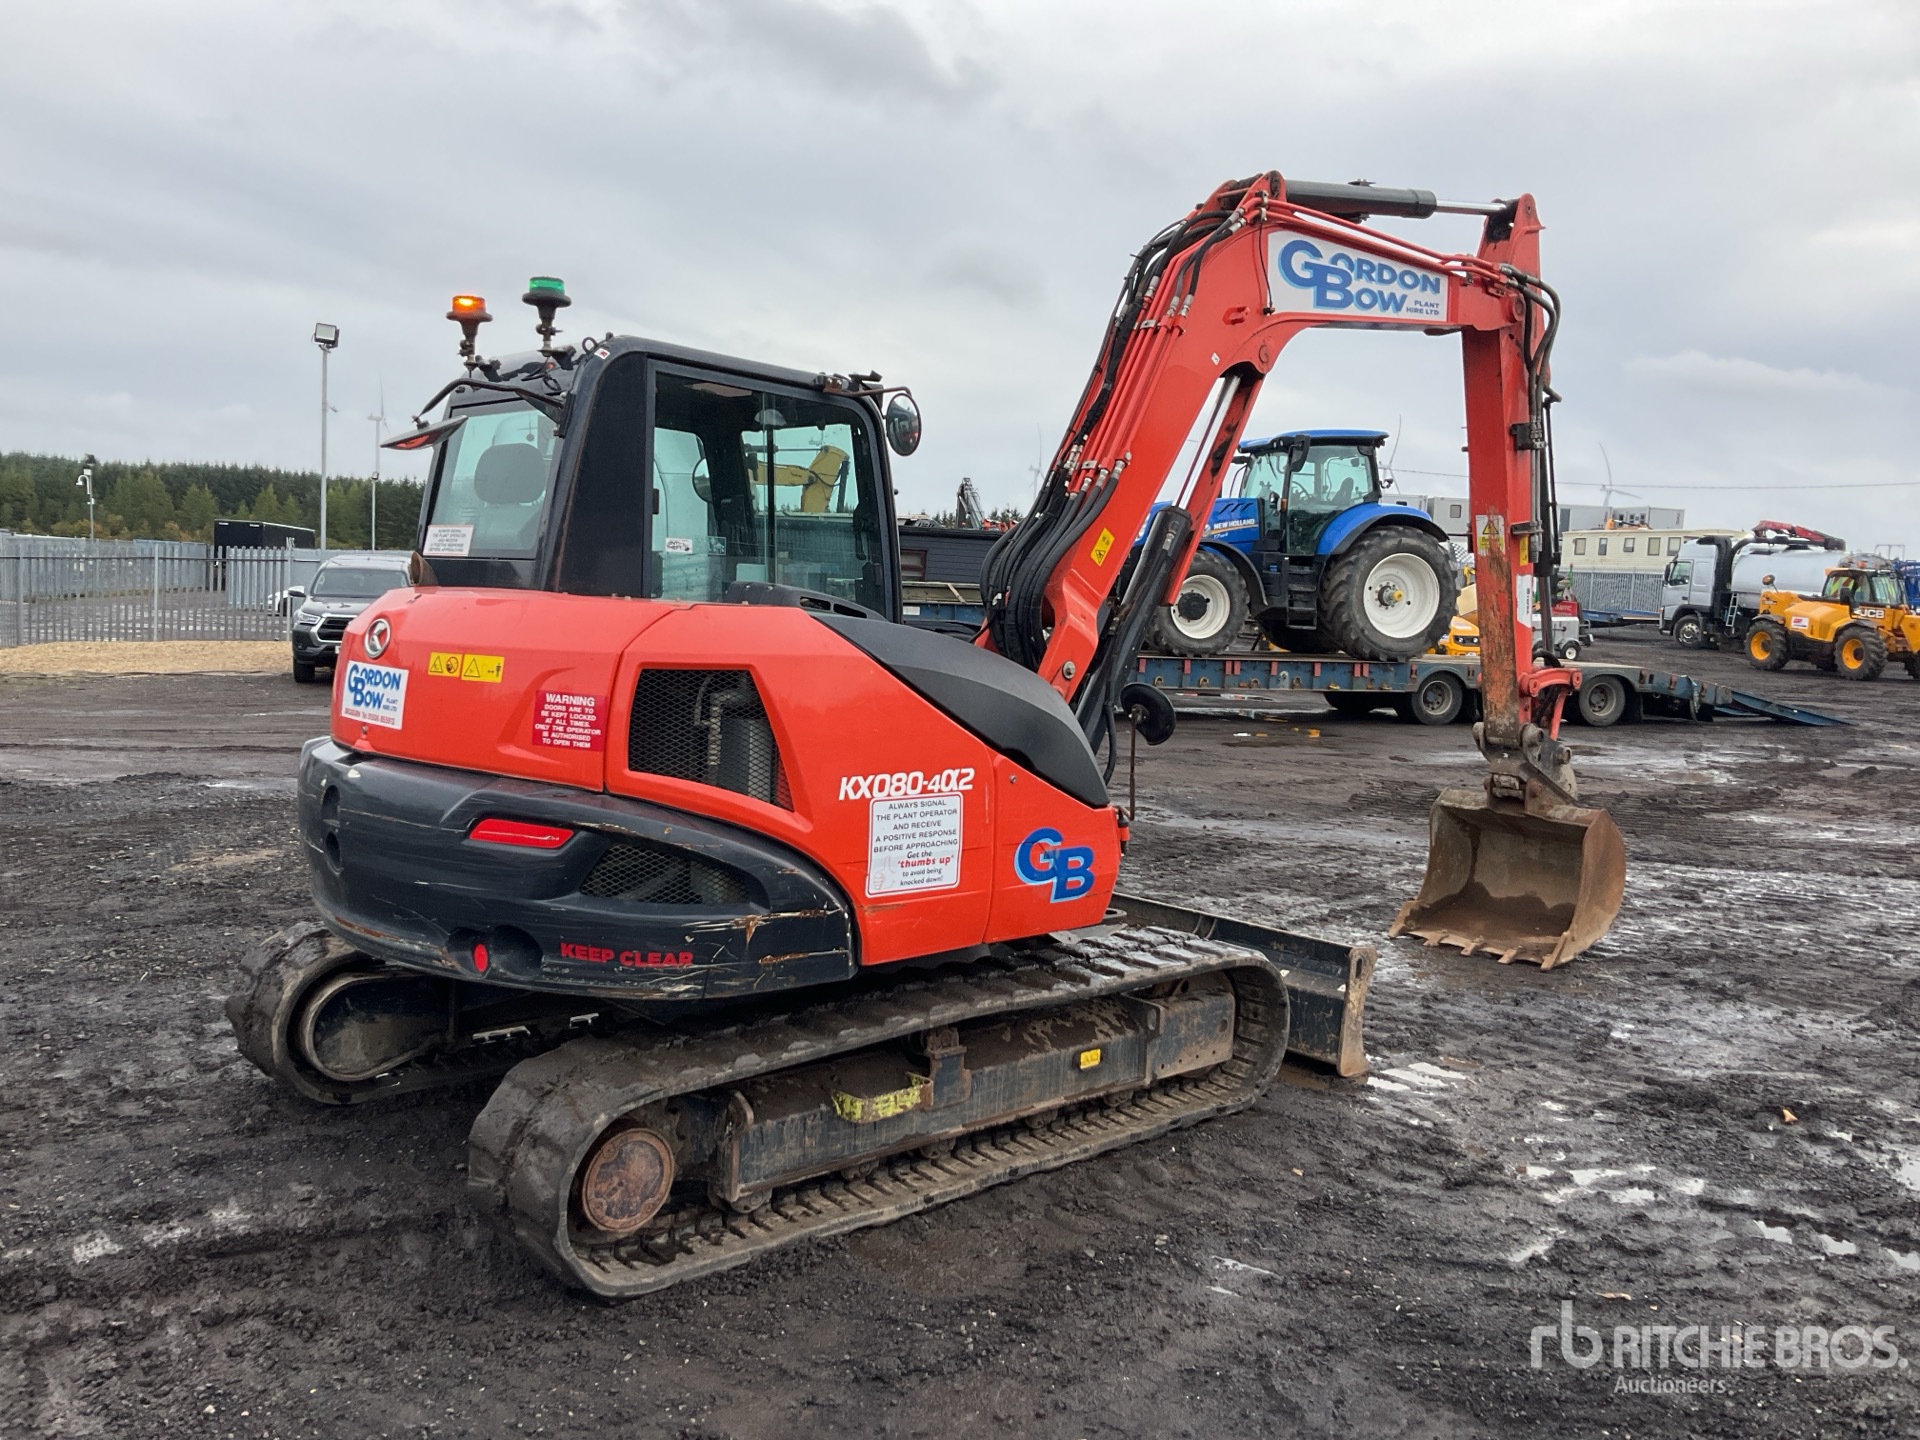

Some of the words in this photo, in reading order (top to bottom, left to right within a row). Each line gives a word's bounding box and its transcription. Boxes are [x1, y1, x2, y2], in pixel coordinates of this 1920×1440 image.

[1278, 239, 1441, 296] GORDON
[1304, 261, 1408, 314] BOW
[1414, 300, 1440, 309] PLANT
[1406, 306, 1424, 315] HIRE
[1425, 308, 1440, 316] LTD
[1213, 521, 1229, 530] NEW
[1229, 518, 1255, 527] HOLLAND
[1860, 609, 1885, 619] JCB
[348, 664, 401, 692] GORDON
[353, 677, 384, 709] BOW
[546, 693, 595, 706] WARNING
[551, 711, 568, 719] KEPT
[569, 713, 597, 721] LOCKED
[566, 726, 602, 735] OPERATOR
[550, 732, 591, 741] AUTHORISED
[888, 801, 918, 810] ALWAYS
[920, 799, 946, 808] SIGNAL
[893, 811, 918, 820] PLANT
[919, 808, 958, 818] OPERATOR
[911, 820, 942, 829] RECEIVE
[883, 832, 917, 841] POSITIVE
[918, 829, 957, 838] RESPONSE
[873, 844, 904, 853] BEFORE
[905, 838, 958, 850] APPROACHING
[906, 851, 920, 859] Get
[1014, 827, 1095, 904] GB
[910, 868, 925, 876] avoid
[926, 867, 942, 875] being
[900, 877, 925, 886] knocked
[561, 942, 615, 963] KEEP
[619, 949, 694, 968] CLEAR
